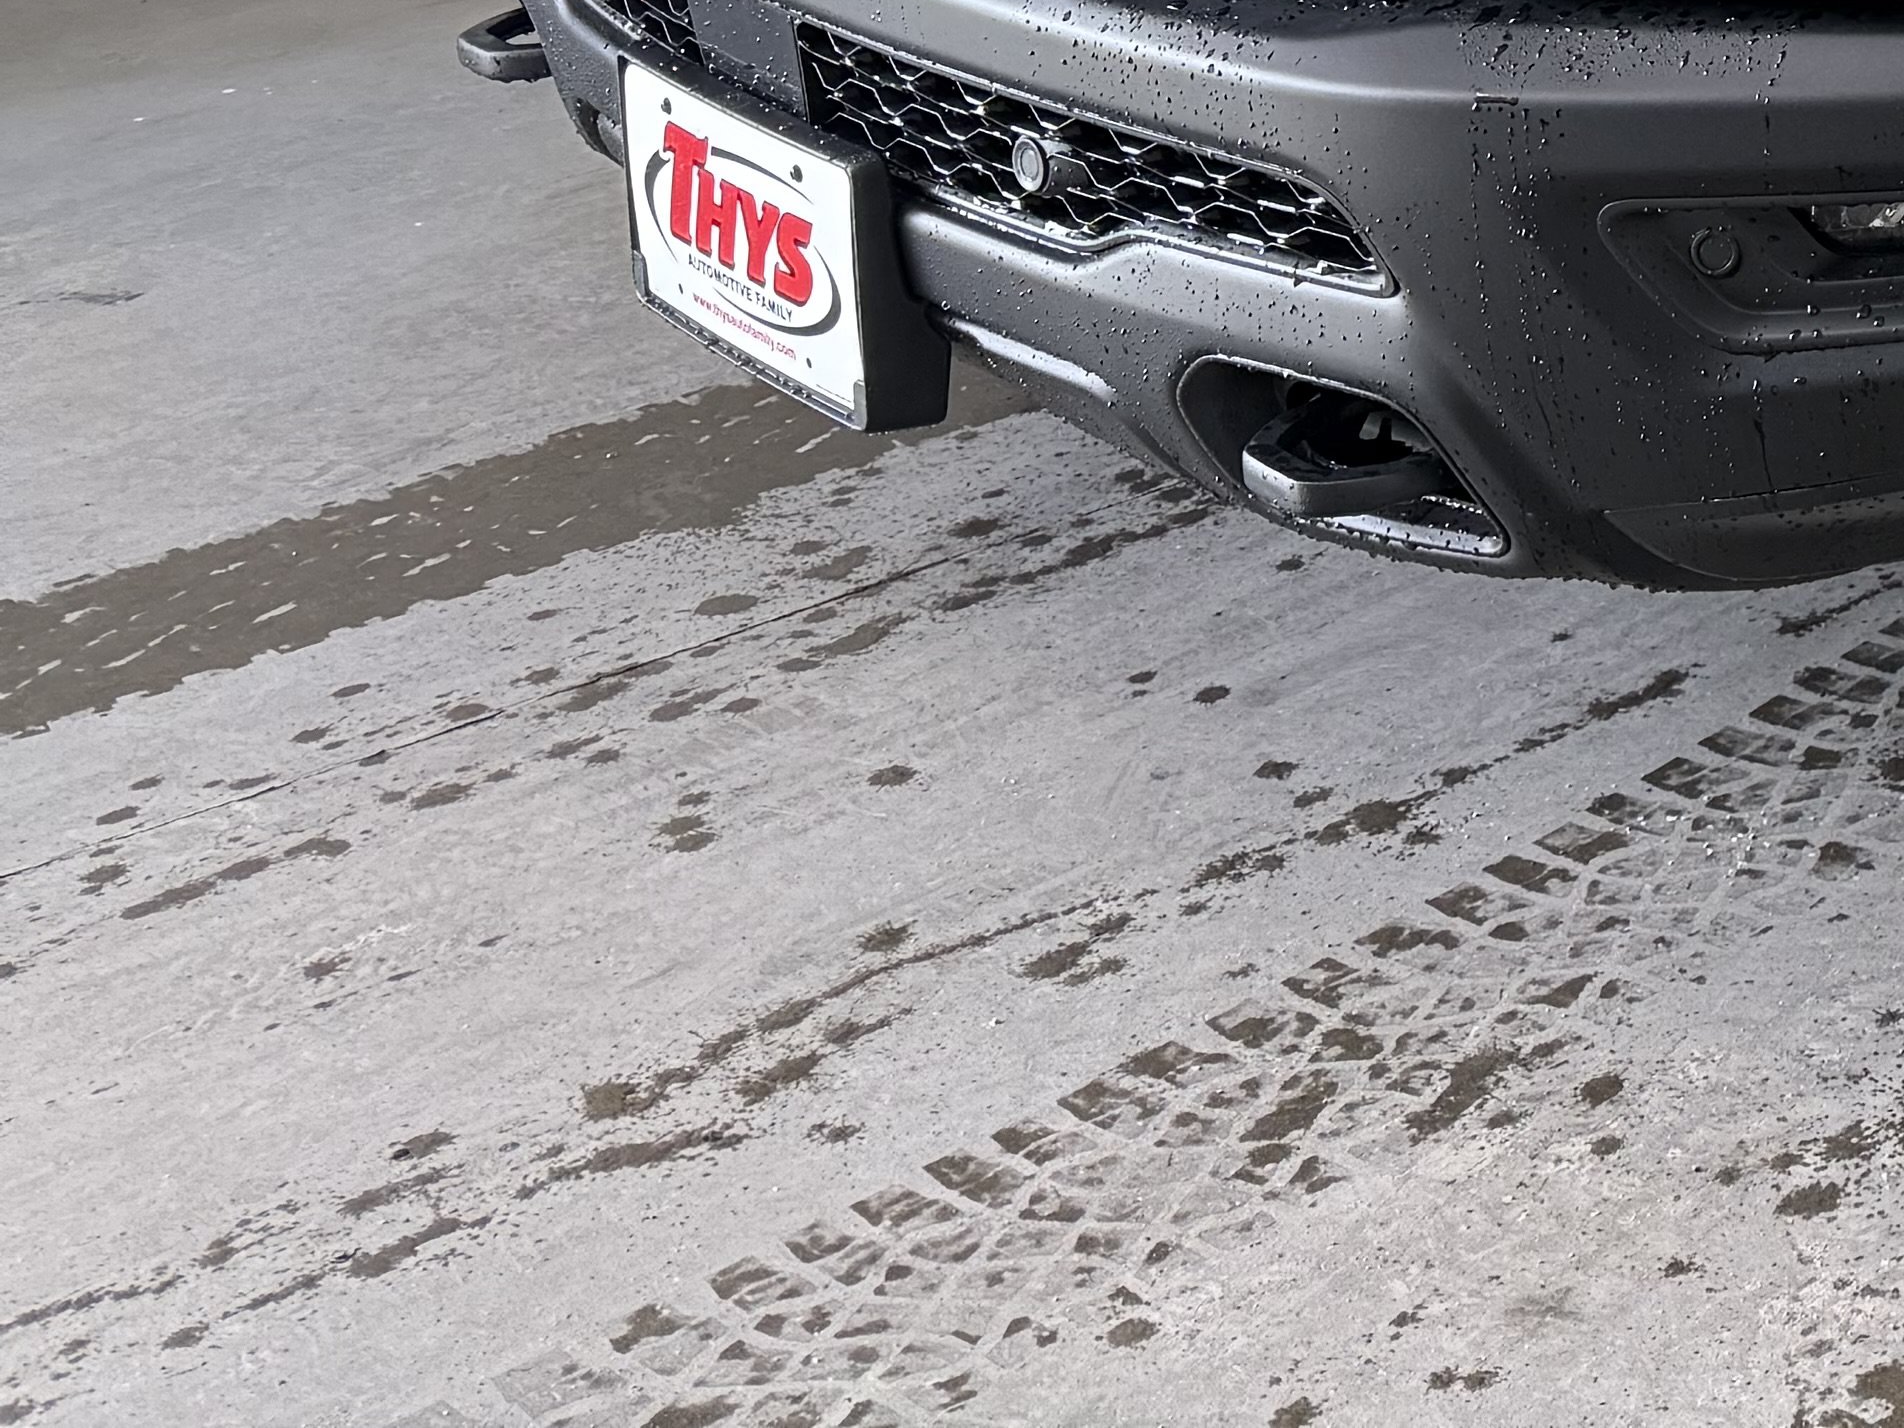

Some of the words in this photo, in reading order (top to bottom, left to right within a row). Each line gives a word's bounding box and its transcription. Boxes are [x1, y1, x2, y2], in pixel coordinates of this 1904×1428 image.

[662, 120, 814, 308] THYS
[688, 252, 753, 302] AUTOMOTIVE
[754, 290, 793, 322] FAMILY
